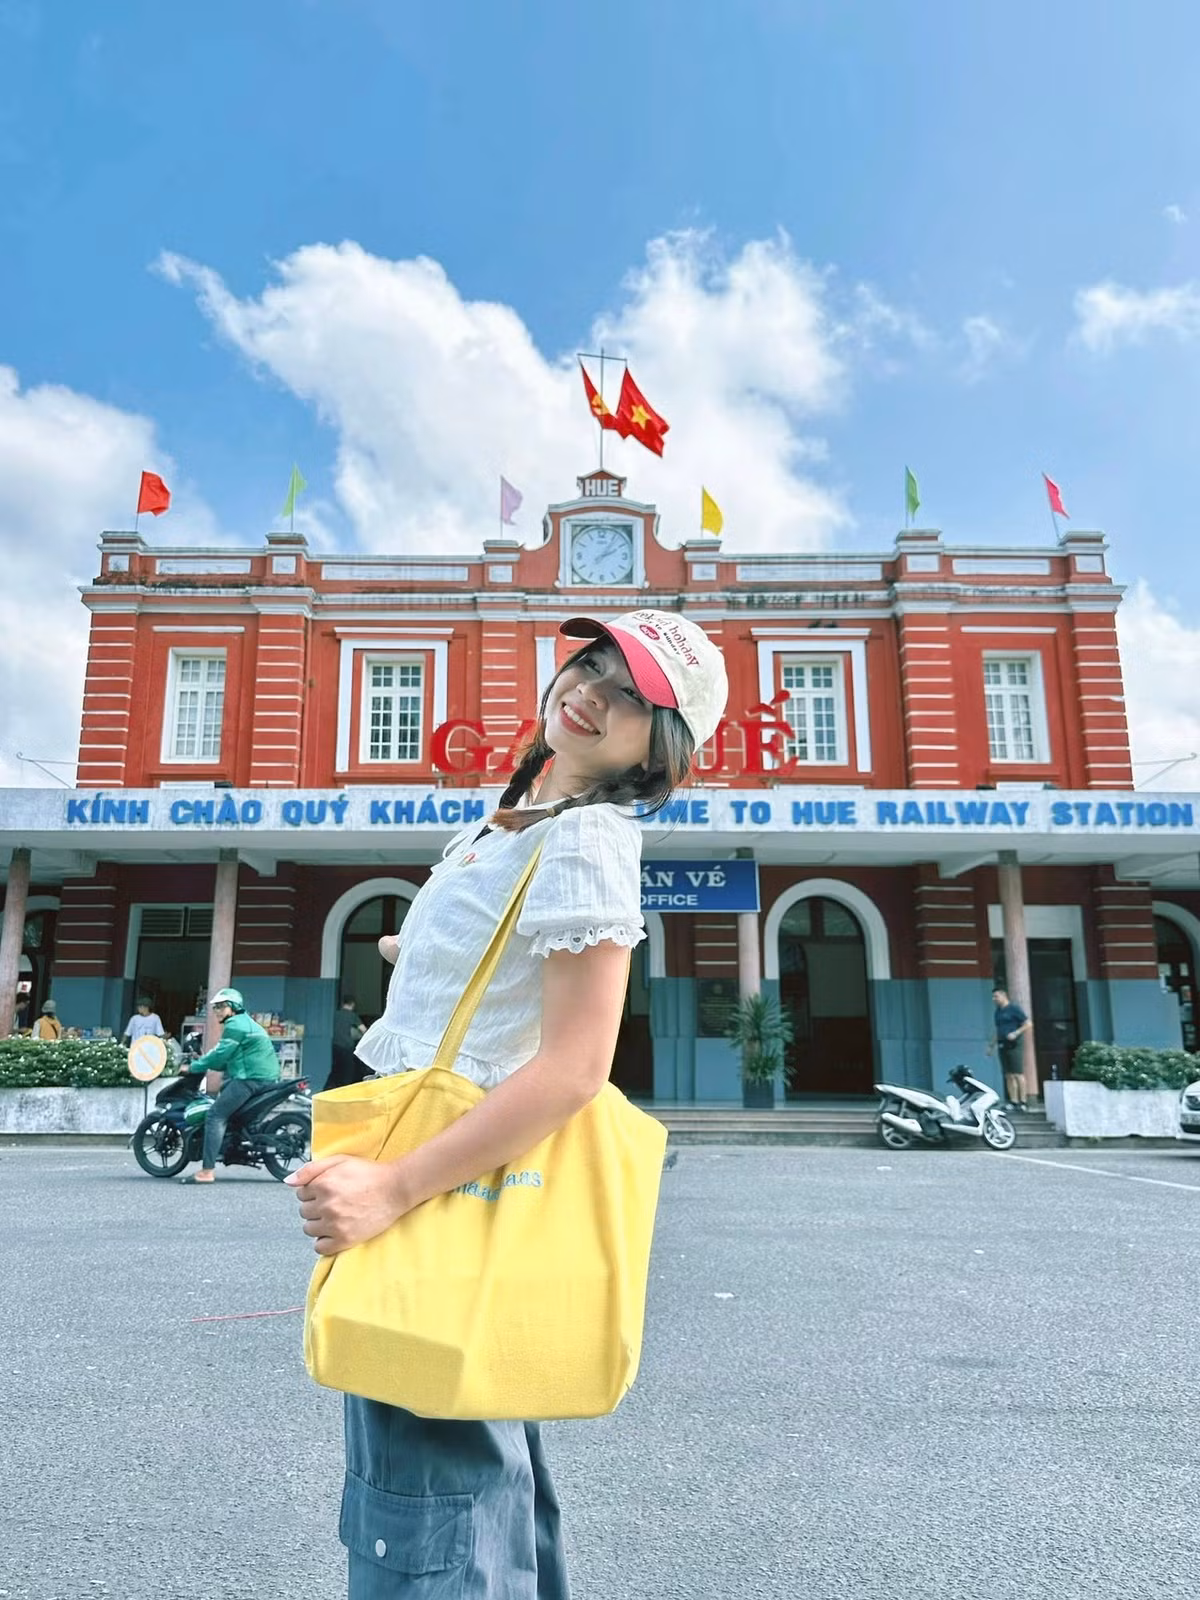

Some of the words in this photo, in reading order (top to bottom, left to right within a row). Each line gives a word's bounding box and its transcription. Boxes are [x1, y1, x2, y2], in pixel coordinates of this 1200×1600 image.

[585, 479, 619, 496] HUE
[668, 625, 700, 667] holiday
[67, 792, 150, 824] KÍNH
[170, 793, 263, 825] CHÀO
[281, 793, 350, 827] QUÝ
[370, 793, 485, 825] KHÁCH
[730, 800, 772, 825] TO
[791, 801, 858, 825] HUE
[876, 801, 1030, 826] RAILWAY
[1051, 802, 1194, 827] STATION
[686, 864, 727, 888] VÉ
